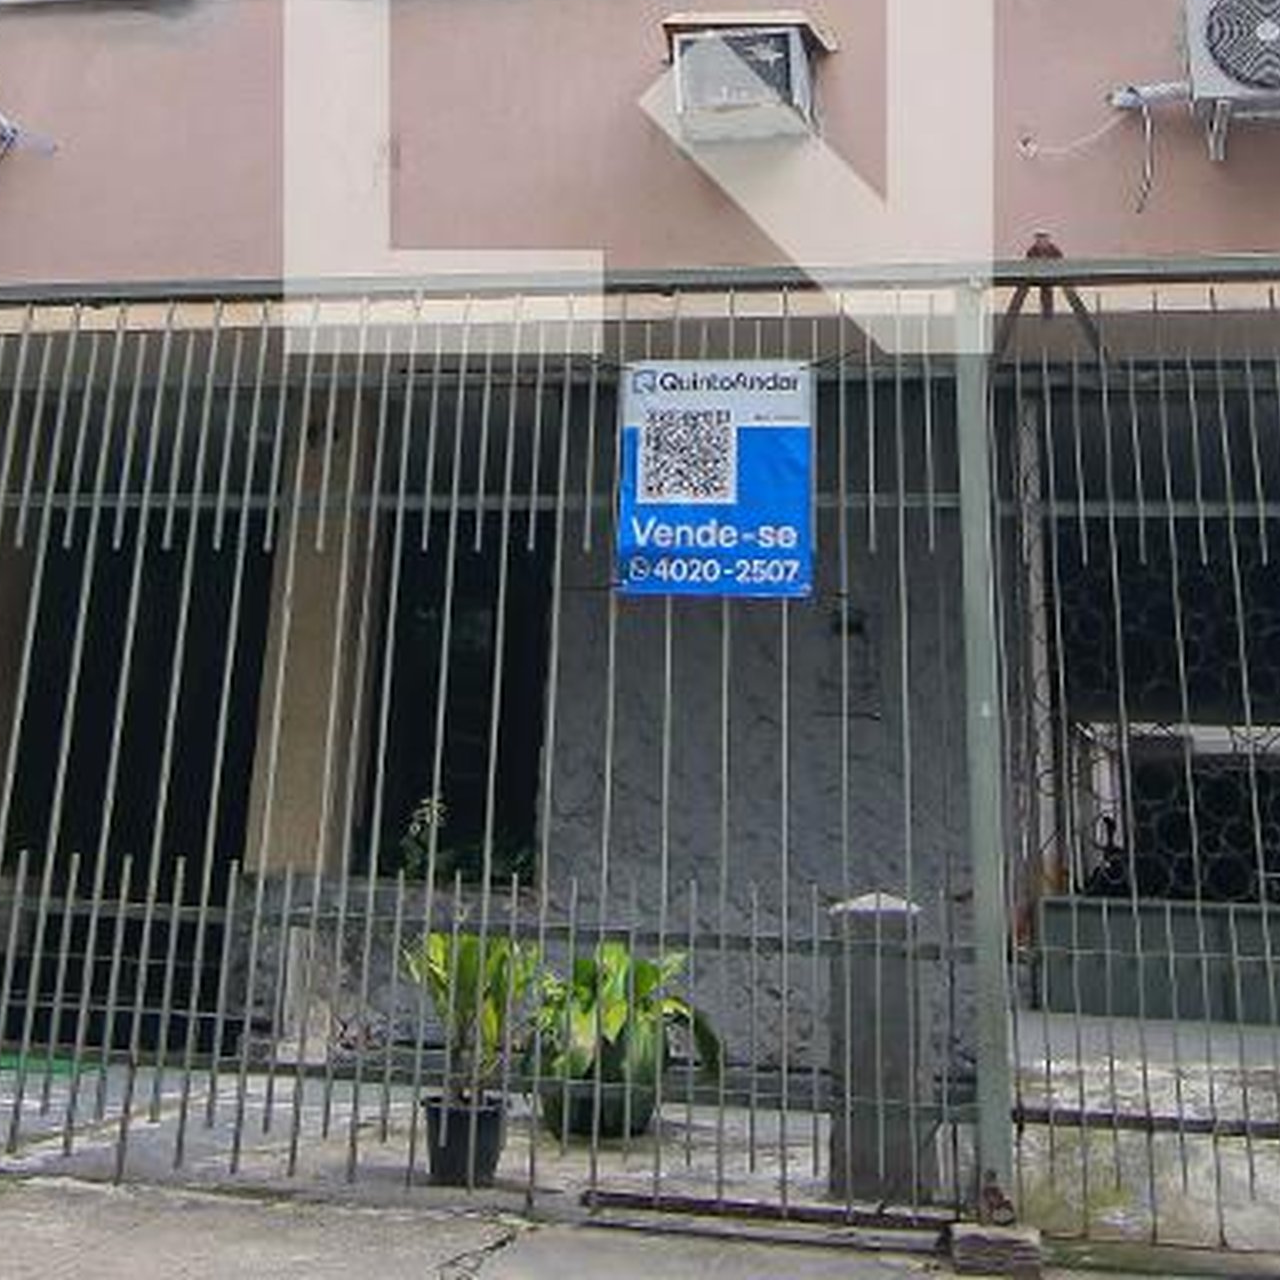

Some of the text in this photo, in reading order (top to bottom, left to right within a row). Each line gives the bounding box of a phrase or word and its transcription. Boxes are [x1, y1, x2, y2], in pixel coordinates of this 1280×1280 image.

[659, 372, 798, 391] QuintoAndar
[631, 518, 797, 548] Vende-se
[653, 559, 800, 583] 4020-2507
